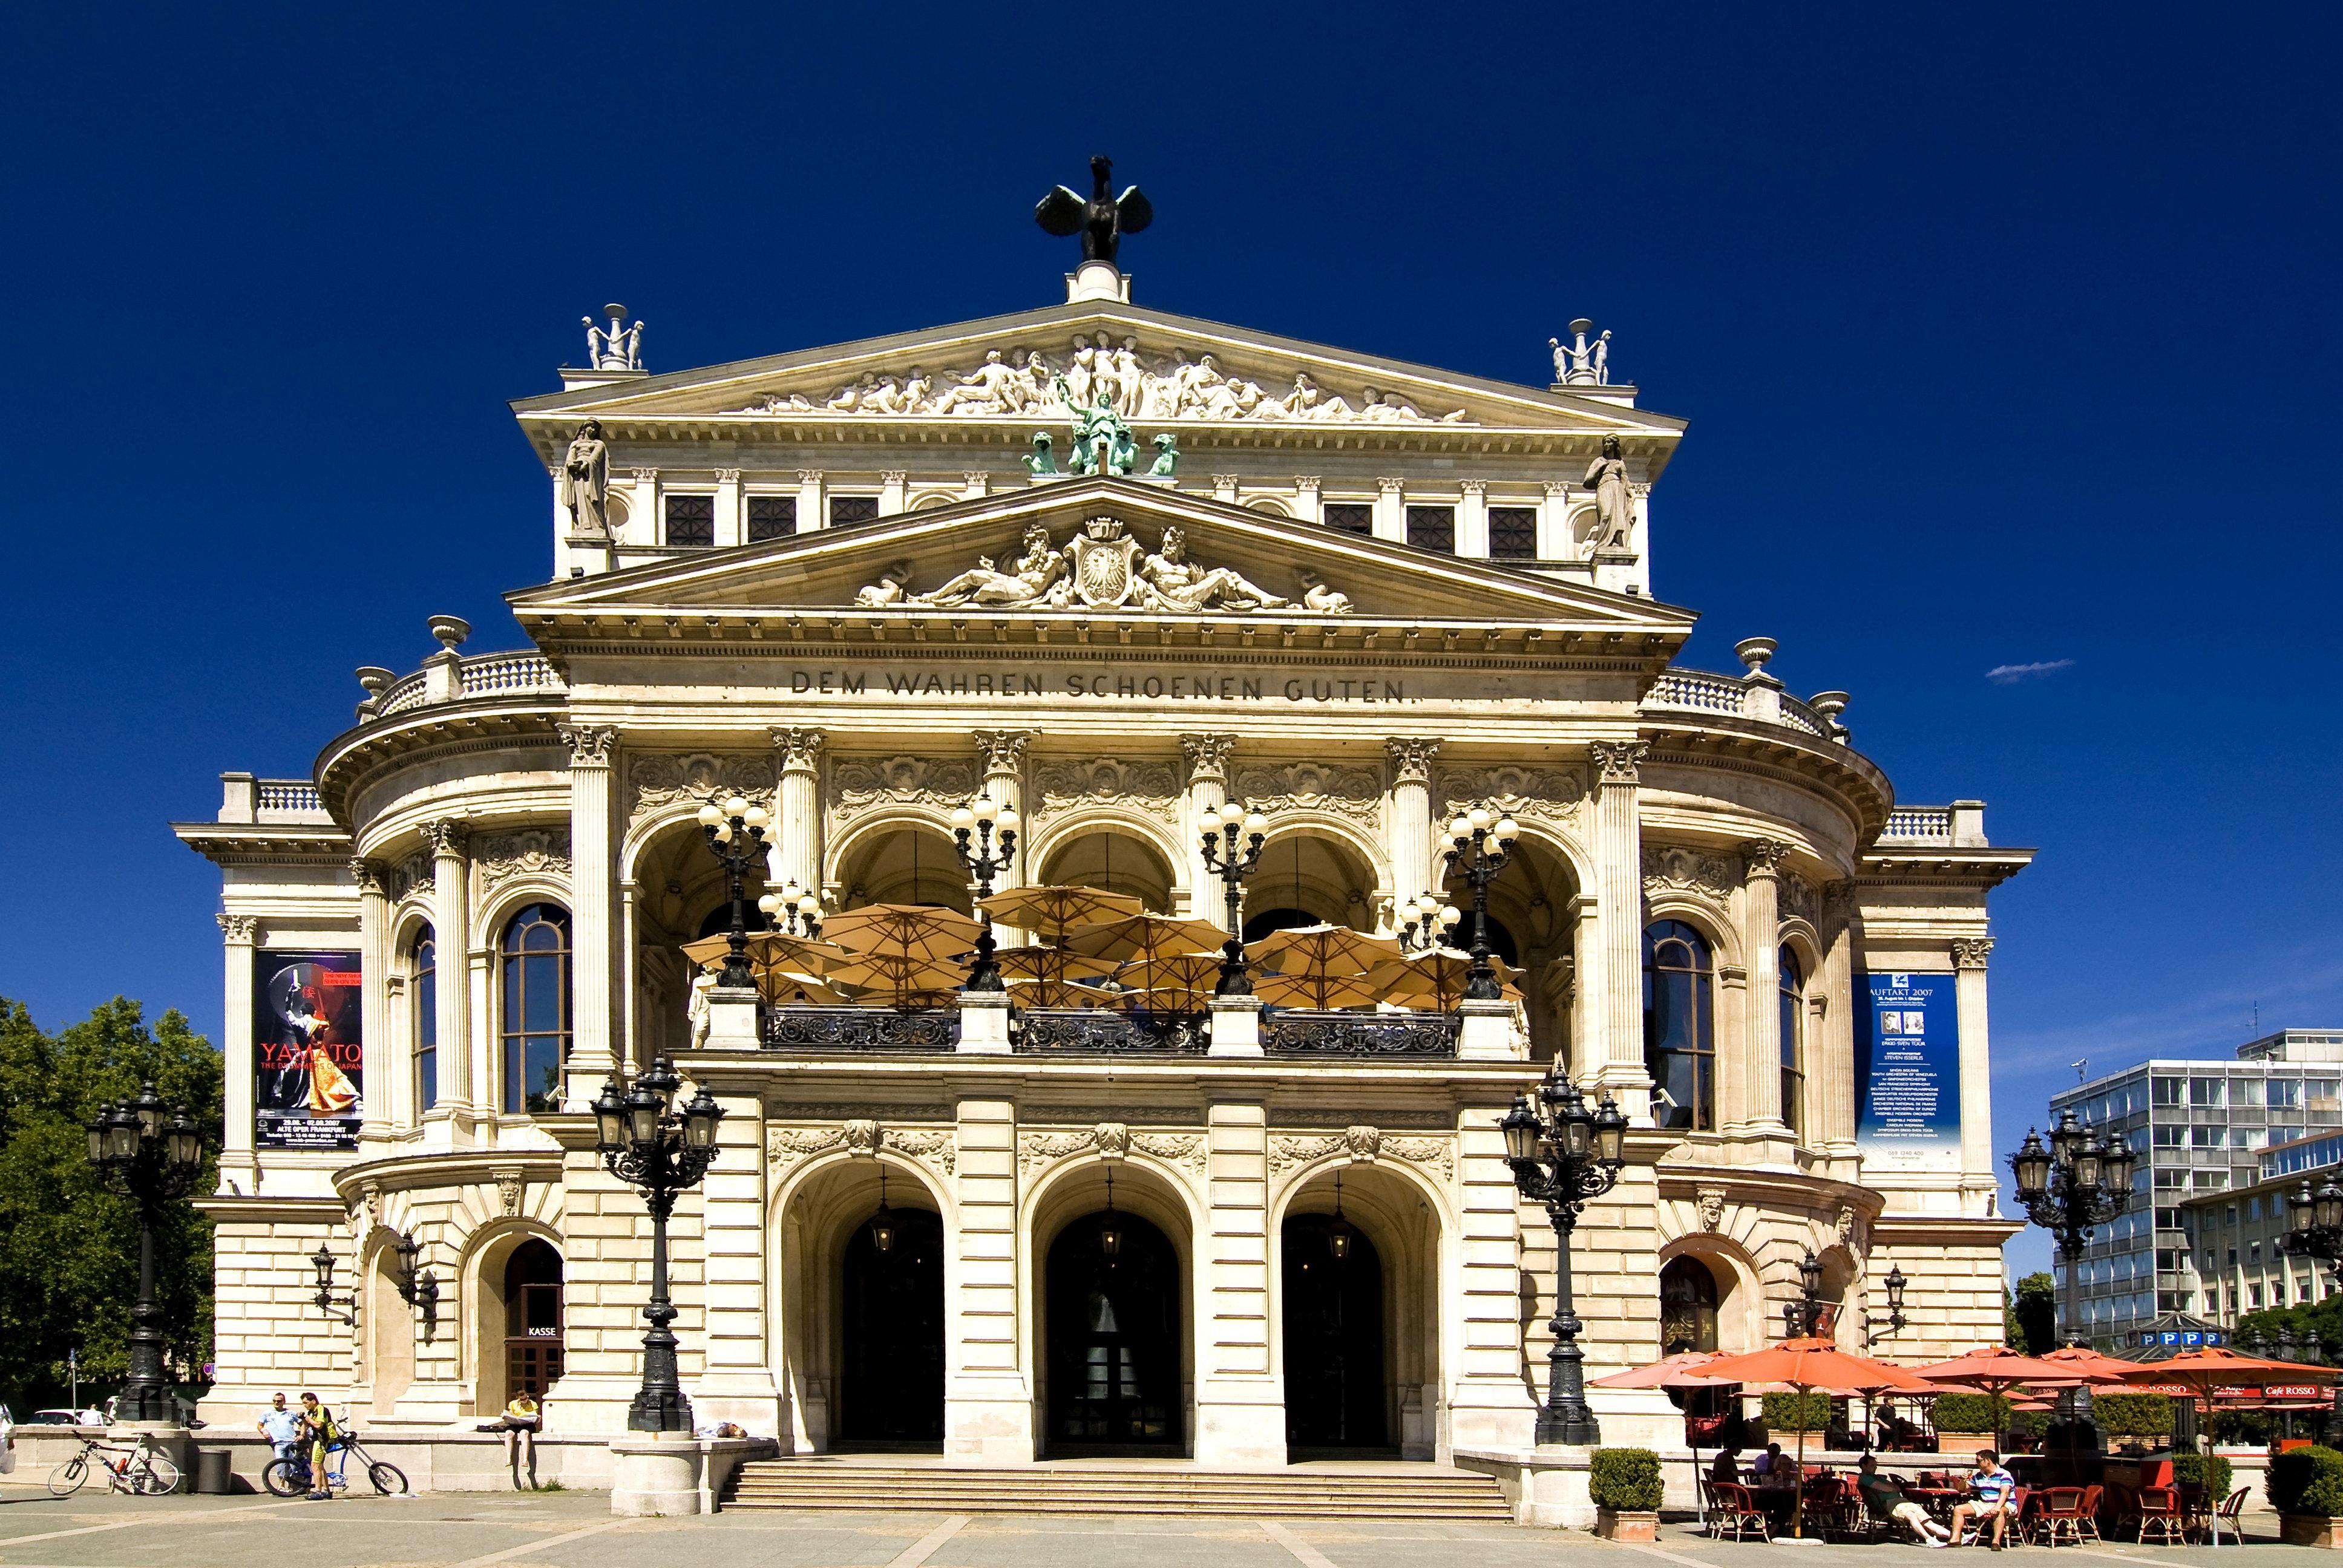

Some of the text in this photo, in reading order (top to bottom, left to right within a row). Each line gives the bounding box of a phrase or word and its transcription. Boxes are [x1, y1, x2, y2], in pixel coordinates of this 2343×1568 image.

[791, 670, 865, 694] DEM
[885, 671, 1042, 696] WAHREN
[1066, 674, 1262, 700] SCHOENEN
[260, 1043, 362, 1062] YAMATO
[529, 1327, 556, 1336] KASSE
[2145, 1335, 2154, 1345] P
[2164, 1334, 2175, 1345] P
[2187, 1334, 2197, 1345] P
[2207, 1334, 2216, 1345] P
[2266, 1387, 2284, 1396] Café
[2286, 1387, 2315, 1396] ROSSO
